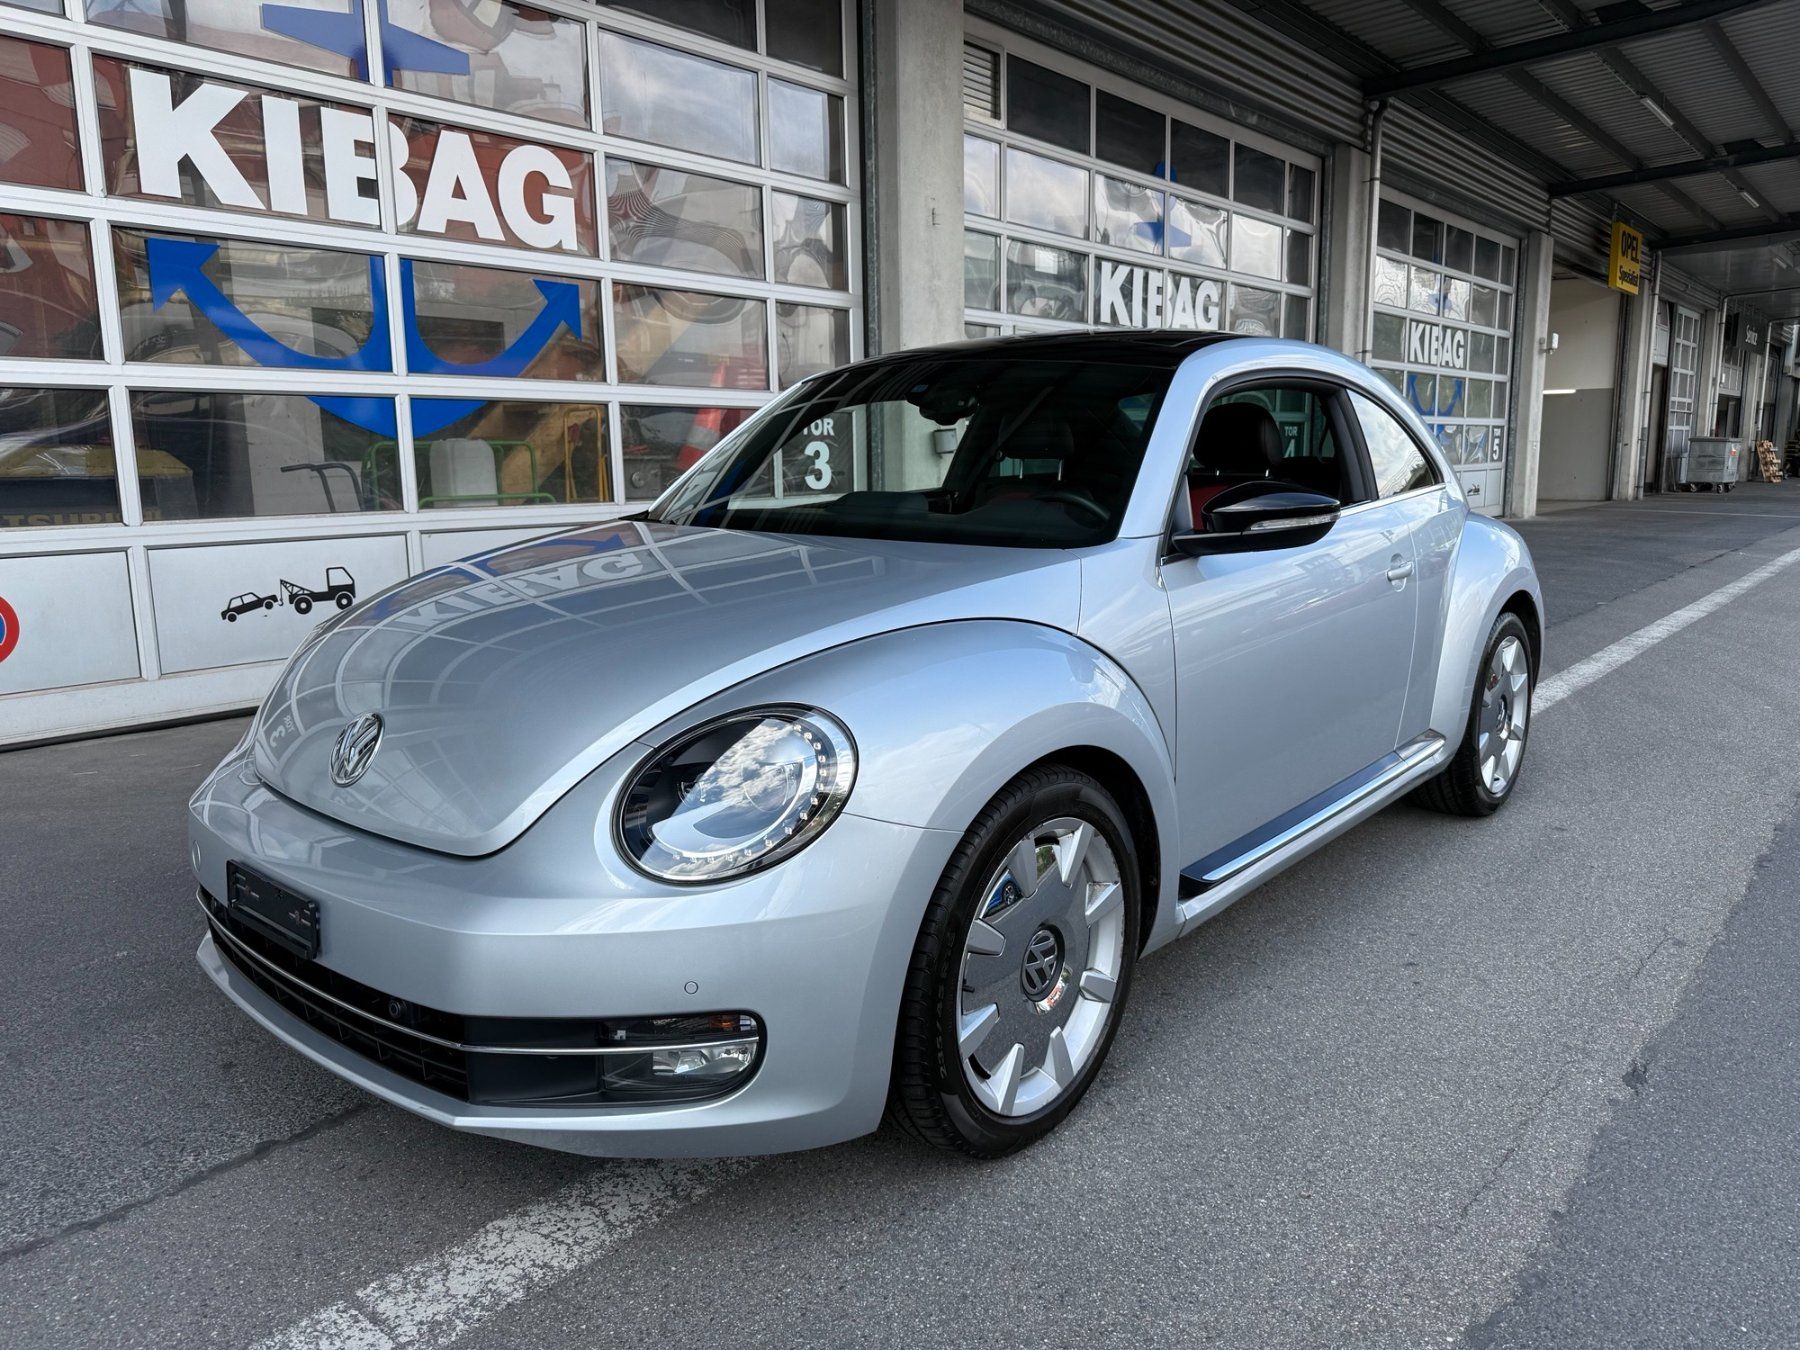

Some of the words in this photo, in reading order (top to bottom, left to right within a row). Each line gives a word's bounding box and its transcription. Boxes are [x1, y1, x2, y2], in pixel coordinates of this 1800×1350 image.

[129, 68, 578, 251] KIBAG
[1621, 230, 1640, 264] OPEL
[1100, 261, 1220, 330] KIBAG
[1409, 321, 1465, 369] KIBAG
[1284, 426, 1298, 437] TOR
[1492, 438, 1500, 460] 5
[804, 441, 832, 490] 3
